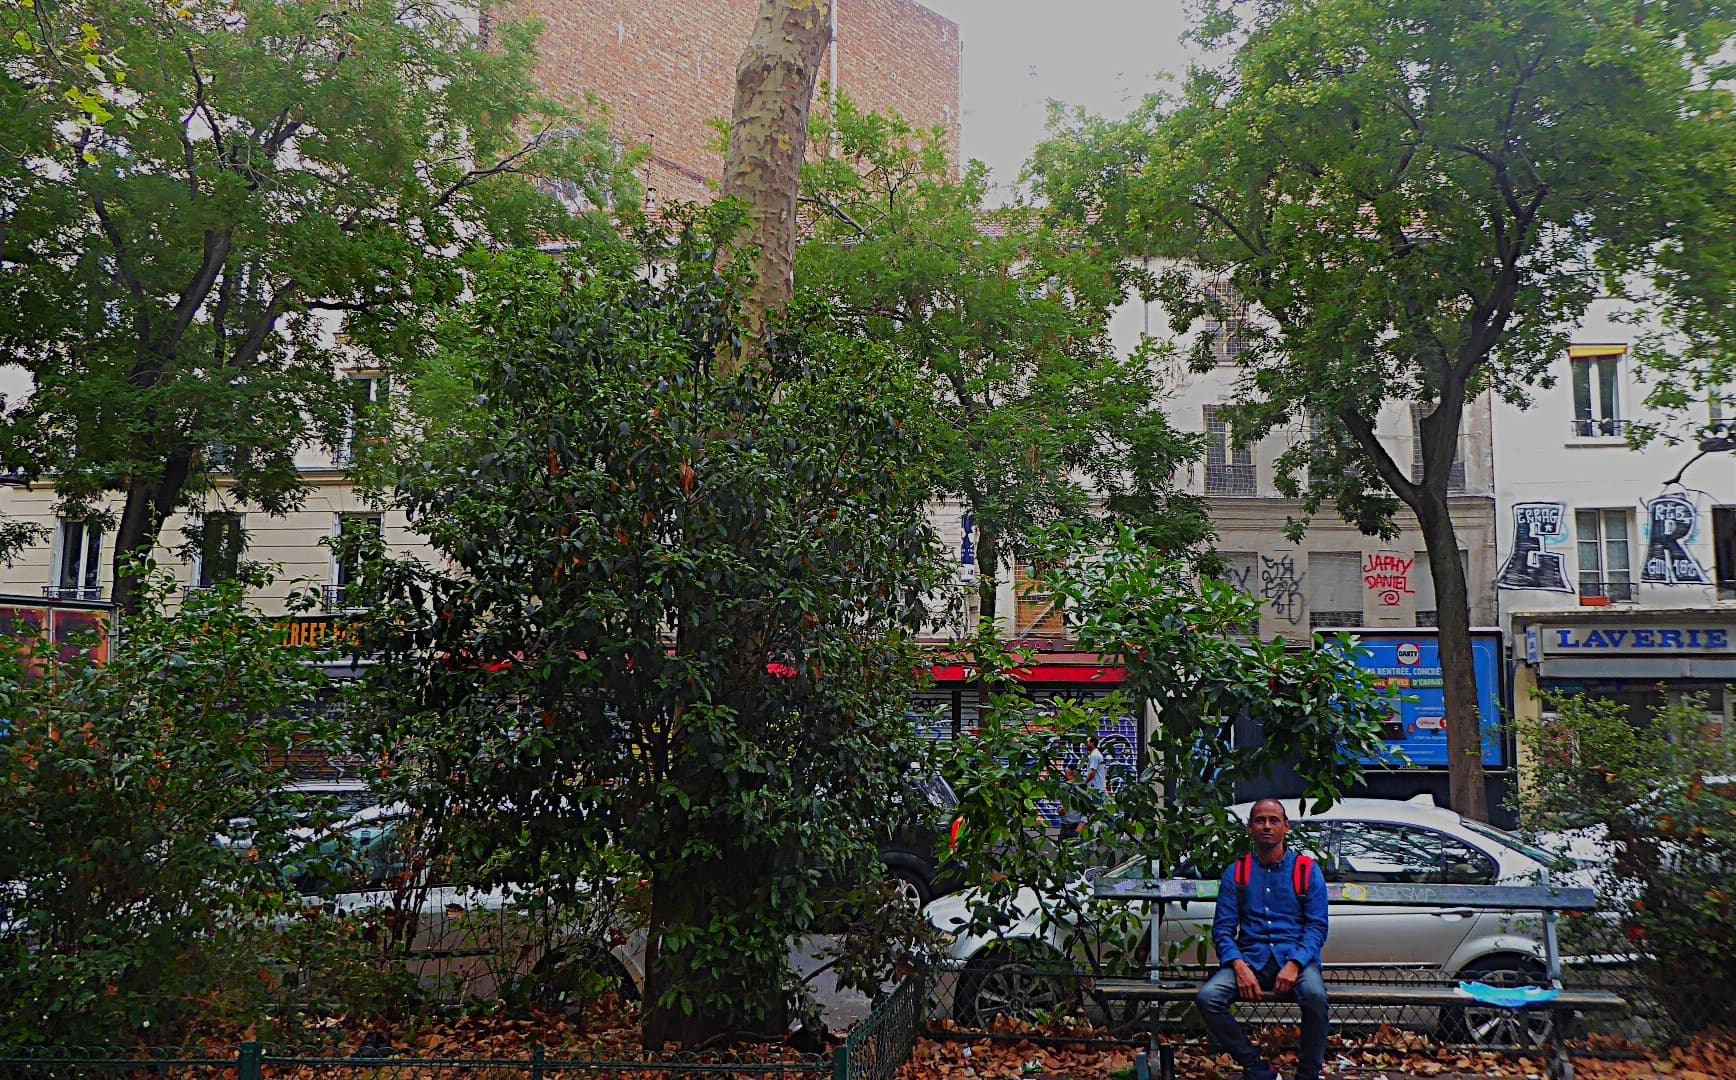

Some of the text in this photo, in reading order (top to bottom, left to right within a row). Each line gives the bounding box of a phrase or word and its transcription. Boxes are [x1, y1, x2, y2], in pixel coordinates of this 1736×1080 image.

[1362, 554, 1415, 574] JAPHY
[1363, 574, 1416, 594] DANIEL
[1556, 629, 1728, 649] LAVERIE
[1397, 649, 1419, 658] DARTY
